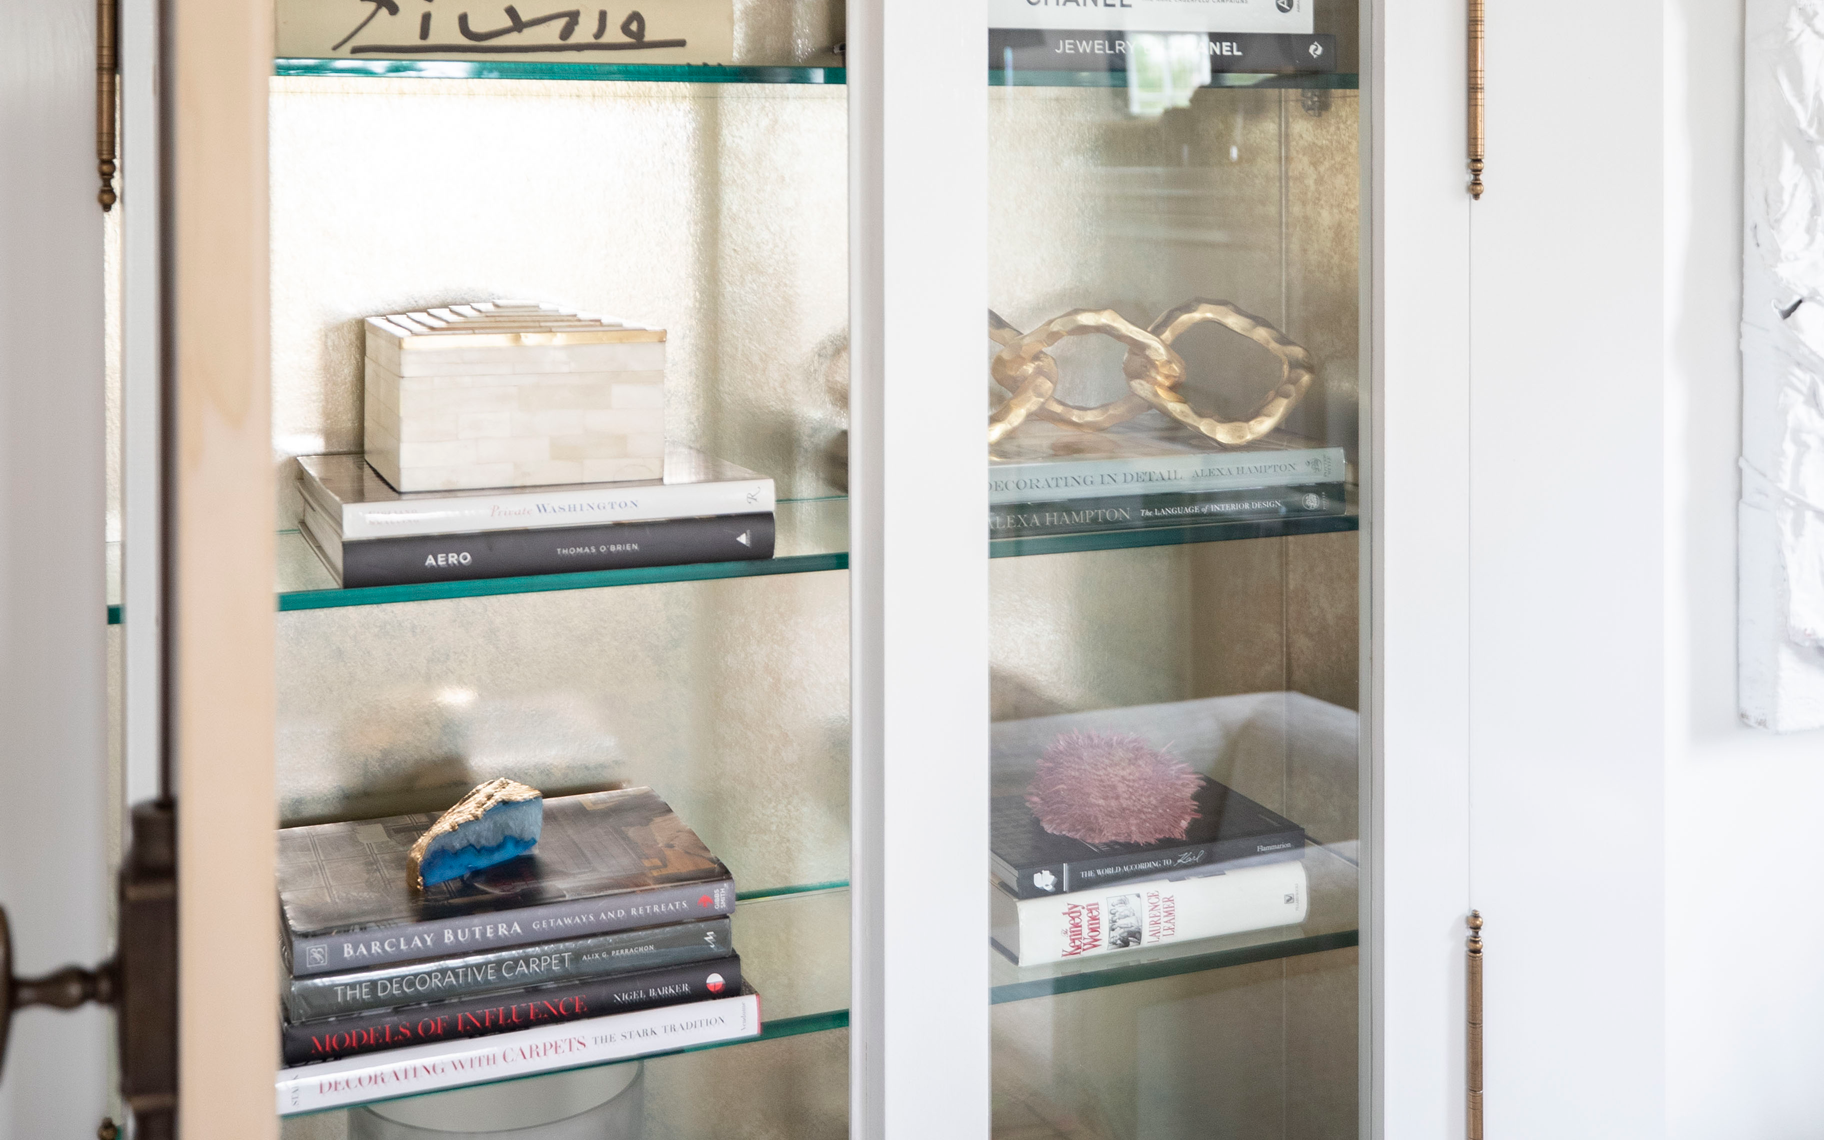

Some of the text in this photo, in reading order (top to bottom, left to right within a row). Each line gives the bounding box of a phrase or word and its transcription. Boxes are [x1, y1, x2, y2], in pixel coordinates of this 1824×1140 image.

[1055, 39, 1136, 55] JEWELRY
[1100, 472, 1118, 485] IN
[1123, 469, 1183, 484] DETAIL
[1191, 462, 1297, 478] ALEXA HAMPTON
[489, 499, 640, 517] Private WASHINGTON
[1045, 507, 1132, 526] HAMPTON
[1140, 500, 1282, 517] The LANGUAGE of INTERIOR DESIGN
[425, 551, 472, 567] AERO
[557, 542, 639, 556] THOMAS O'BRIEN
[1256, 841, 1292, 852] Flammarion
[1080, 858, 1172, 879] THE WORLD ACCORDING TO
[532, 900, 689, 931] GETAWAYS AND RETREATS
[1147, 890, 1160, 944] LAURENCE
[1161, 894, 1176, 937] LEAMER
[1061, 902, 1086, 958] Kennedy
[1082, 901, 1102, 952] Women
[343, 920, 523, 959] BARCLAY BUTERA
[581, 944, 654, 961] ALIX G. PERRACHON
[334, 951, 572, 1002] THE DECORATIVE CARPET
[613, 982, 690, 1004] NIGEL BARKER
[311, 995, 587, 1054] MODELS OF INFLUENCE
[591, 1015, 726, 1046] THE STARK TRADITION
[318, 1036, 587, 1095] DECORATING WITH CARPETS
